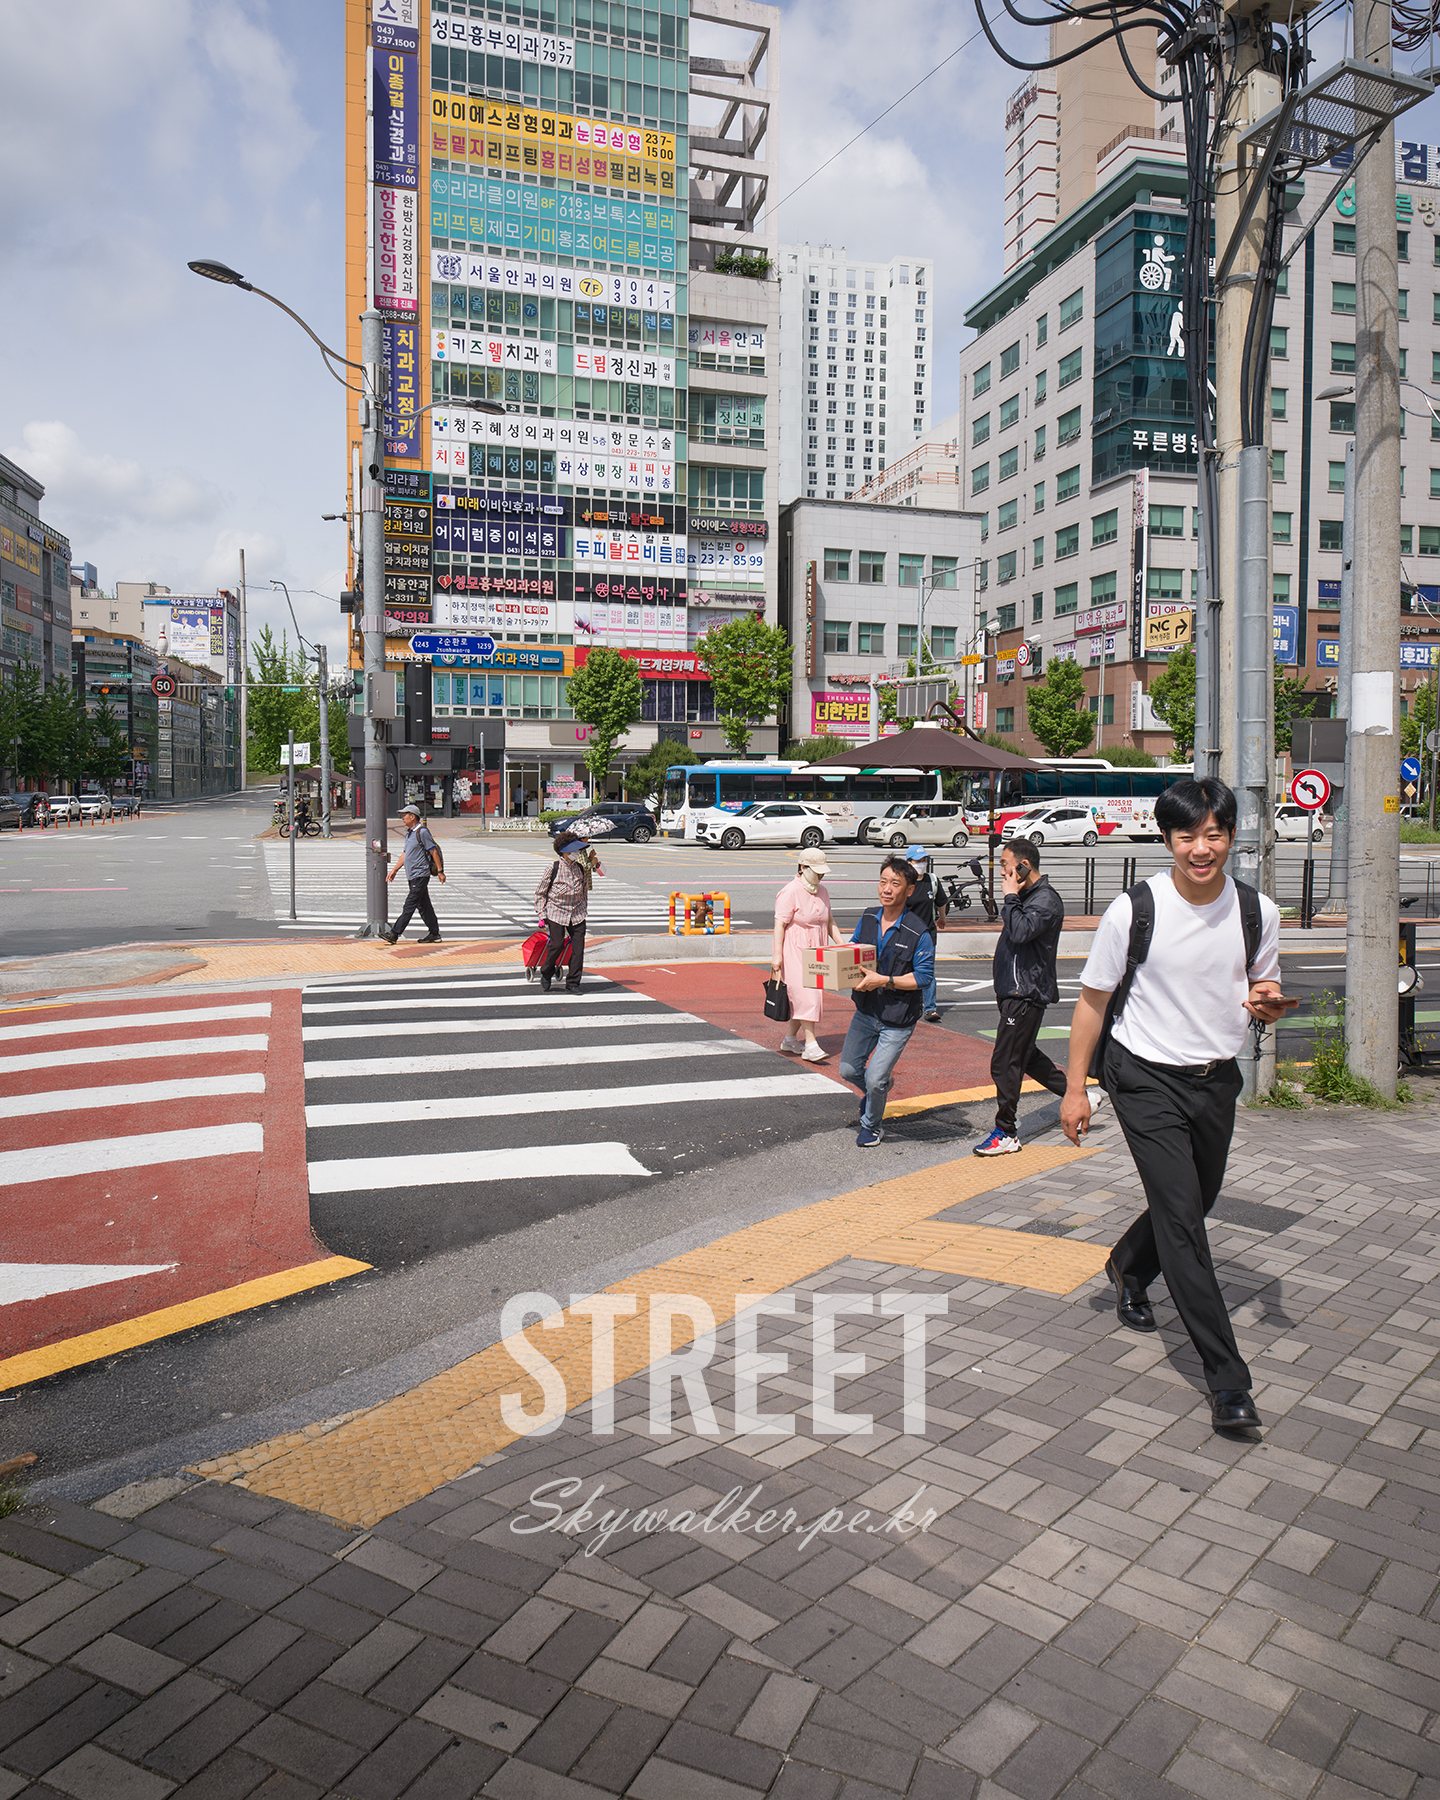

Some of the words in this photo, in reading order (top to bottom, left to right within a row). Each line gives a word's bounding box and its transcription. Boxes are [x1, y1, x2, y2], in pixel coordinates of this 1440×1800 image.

[376, 25, 395, 36] 043)
[432, 18, 539, 57] 성모흉부외과
[376, 35, 416, 49] 237.1500
[543, 51, 572, 65] 7977
[433, 99, 573, 140] 아이에스성형외과
[407, 143, 416, 163] 의원
[647, 146, 674, 160] 1500
[375, 170, 416, 185] 715-5100
[451, 181, 538, 210] 리라클의원
[540, 197, 556, 209] 8F
[560, 207, 590, 220] 0123
[644, 211, 673, 231] 필러
[380, 190, 398, 294] 한음한의원
[433, 212, 483, 235] 리프팅
[524, 225, 555, 245] 기미
[593, 236, 641, 258] 여드름
[644, 244, 674, 262] 모공
[470, 265, 572, 292] 서울안과의원
[583, 281, 599, 293] 7F
[614, 292, 670, 309] 3311
[703, 330, 764, 348] 서울안과
[452, 337, 539, 364] 키즈웰치과
[720, 411, 762, 426] 정신과
[454, 418, 589, 445] 청주혜성외과의원
[611, 431, 672, 451] 항문수술
[436, 449, 465, 466] 치질
[560, 460, 589, 476] 화상
[457, 496, 534, 514] 미래이비인후과
[435, 525, 502, 543] 어지럼증
[507, 530, 555, 547] 이석증
[576, 540, 606, 559] 두피
[610, 543, 639, 561] 탈모
[700, 553, 763, 567] 232-8599
[386, 578, 429, 591] 서울안과
[453, 575, 554, 595] 성모흉부외과의원
[611, 583, 669, 601] 약손명가
[385, 593, 414, 602] 4-3311
[1149, 620, 1171, 634] NC
[1273, 616, 1290, 627] 리닉
[438, 637, 468, 646] 2순환로
[386, 651, 432, 662] 화투자증권
[519, 653, 540, 666] 의원
[633, 658, 695, 672] 드게임카페
[156, 681, 171, 691] 50
[1107, 799, 1133, 807] 2025.9.12
